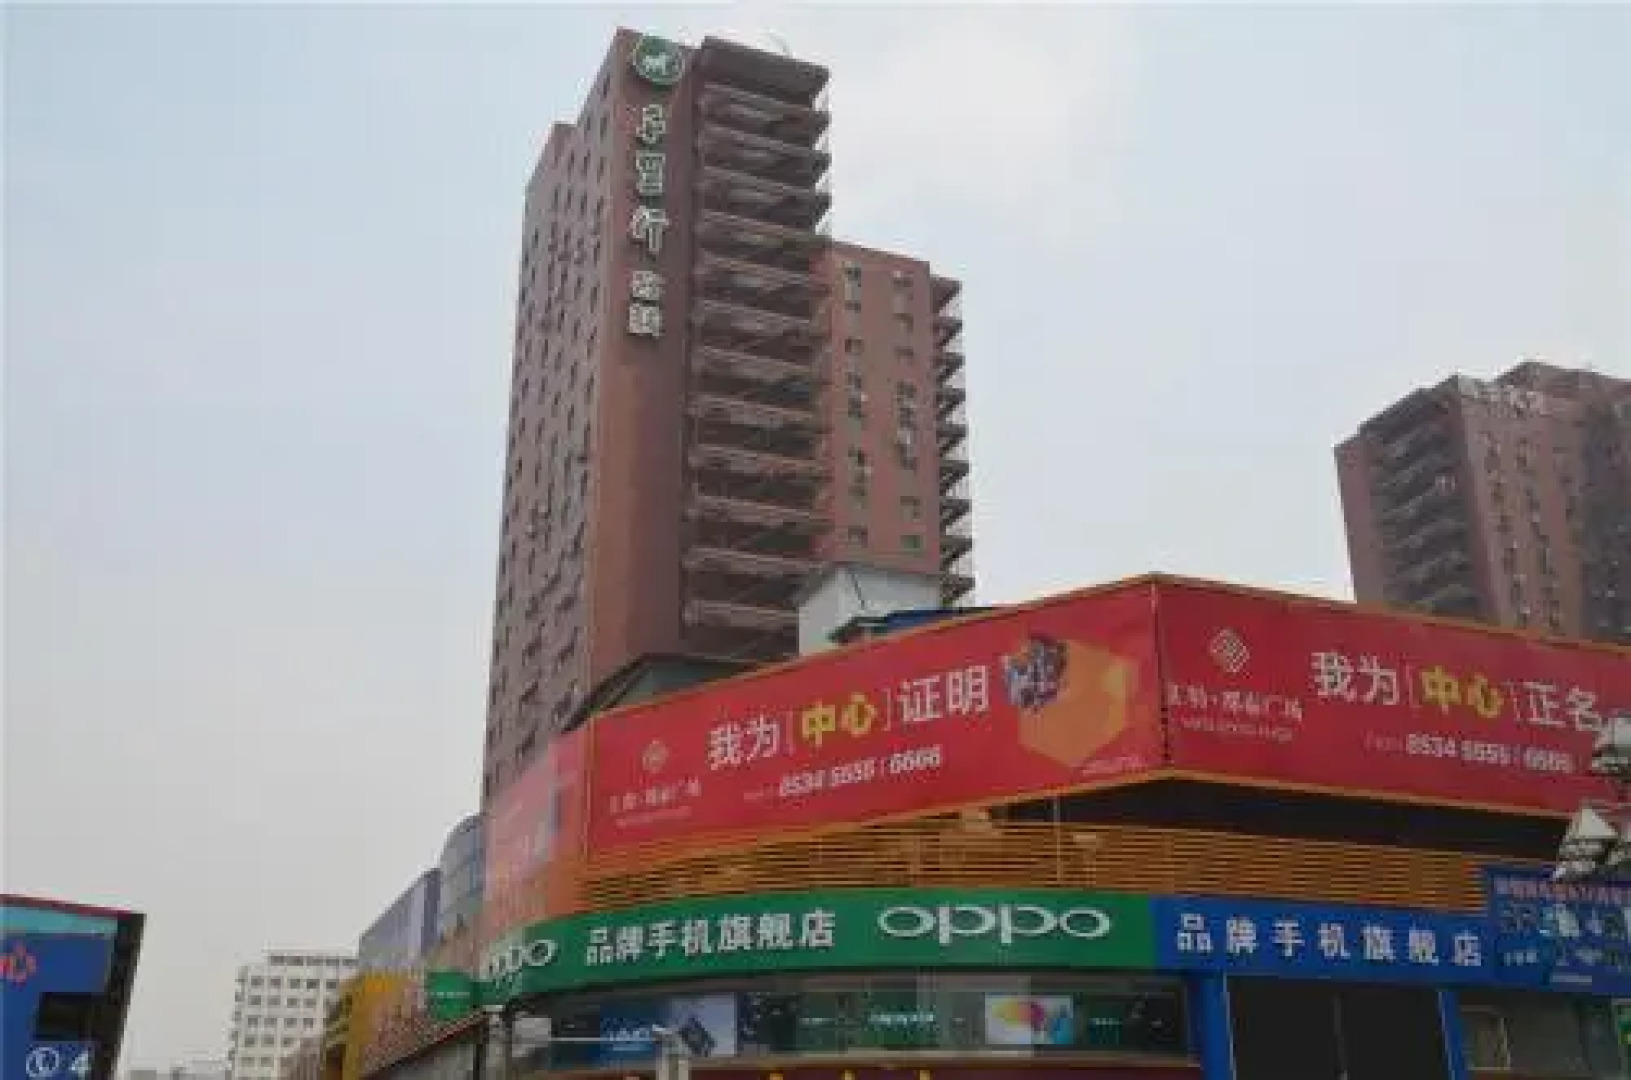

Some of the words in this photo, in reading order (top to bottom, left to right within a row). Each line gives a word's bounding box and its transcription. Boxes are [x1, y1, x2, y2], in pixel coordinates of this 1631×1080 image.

[586, 908, 836, 966] 品牌手机旗舰店
[1176, 913, 1484, 967] 品牌手机旗舰店
